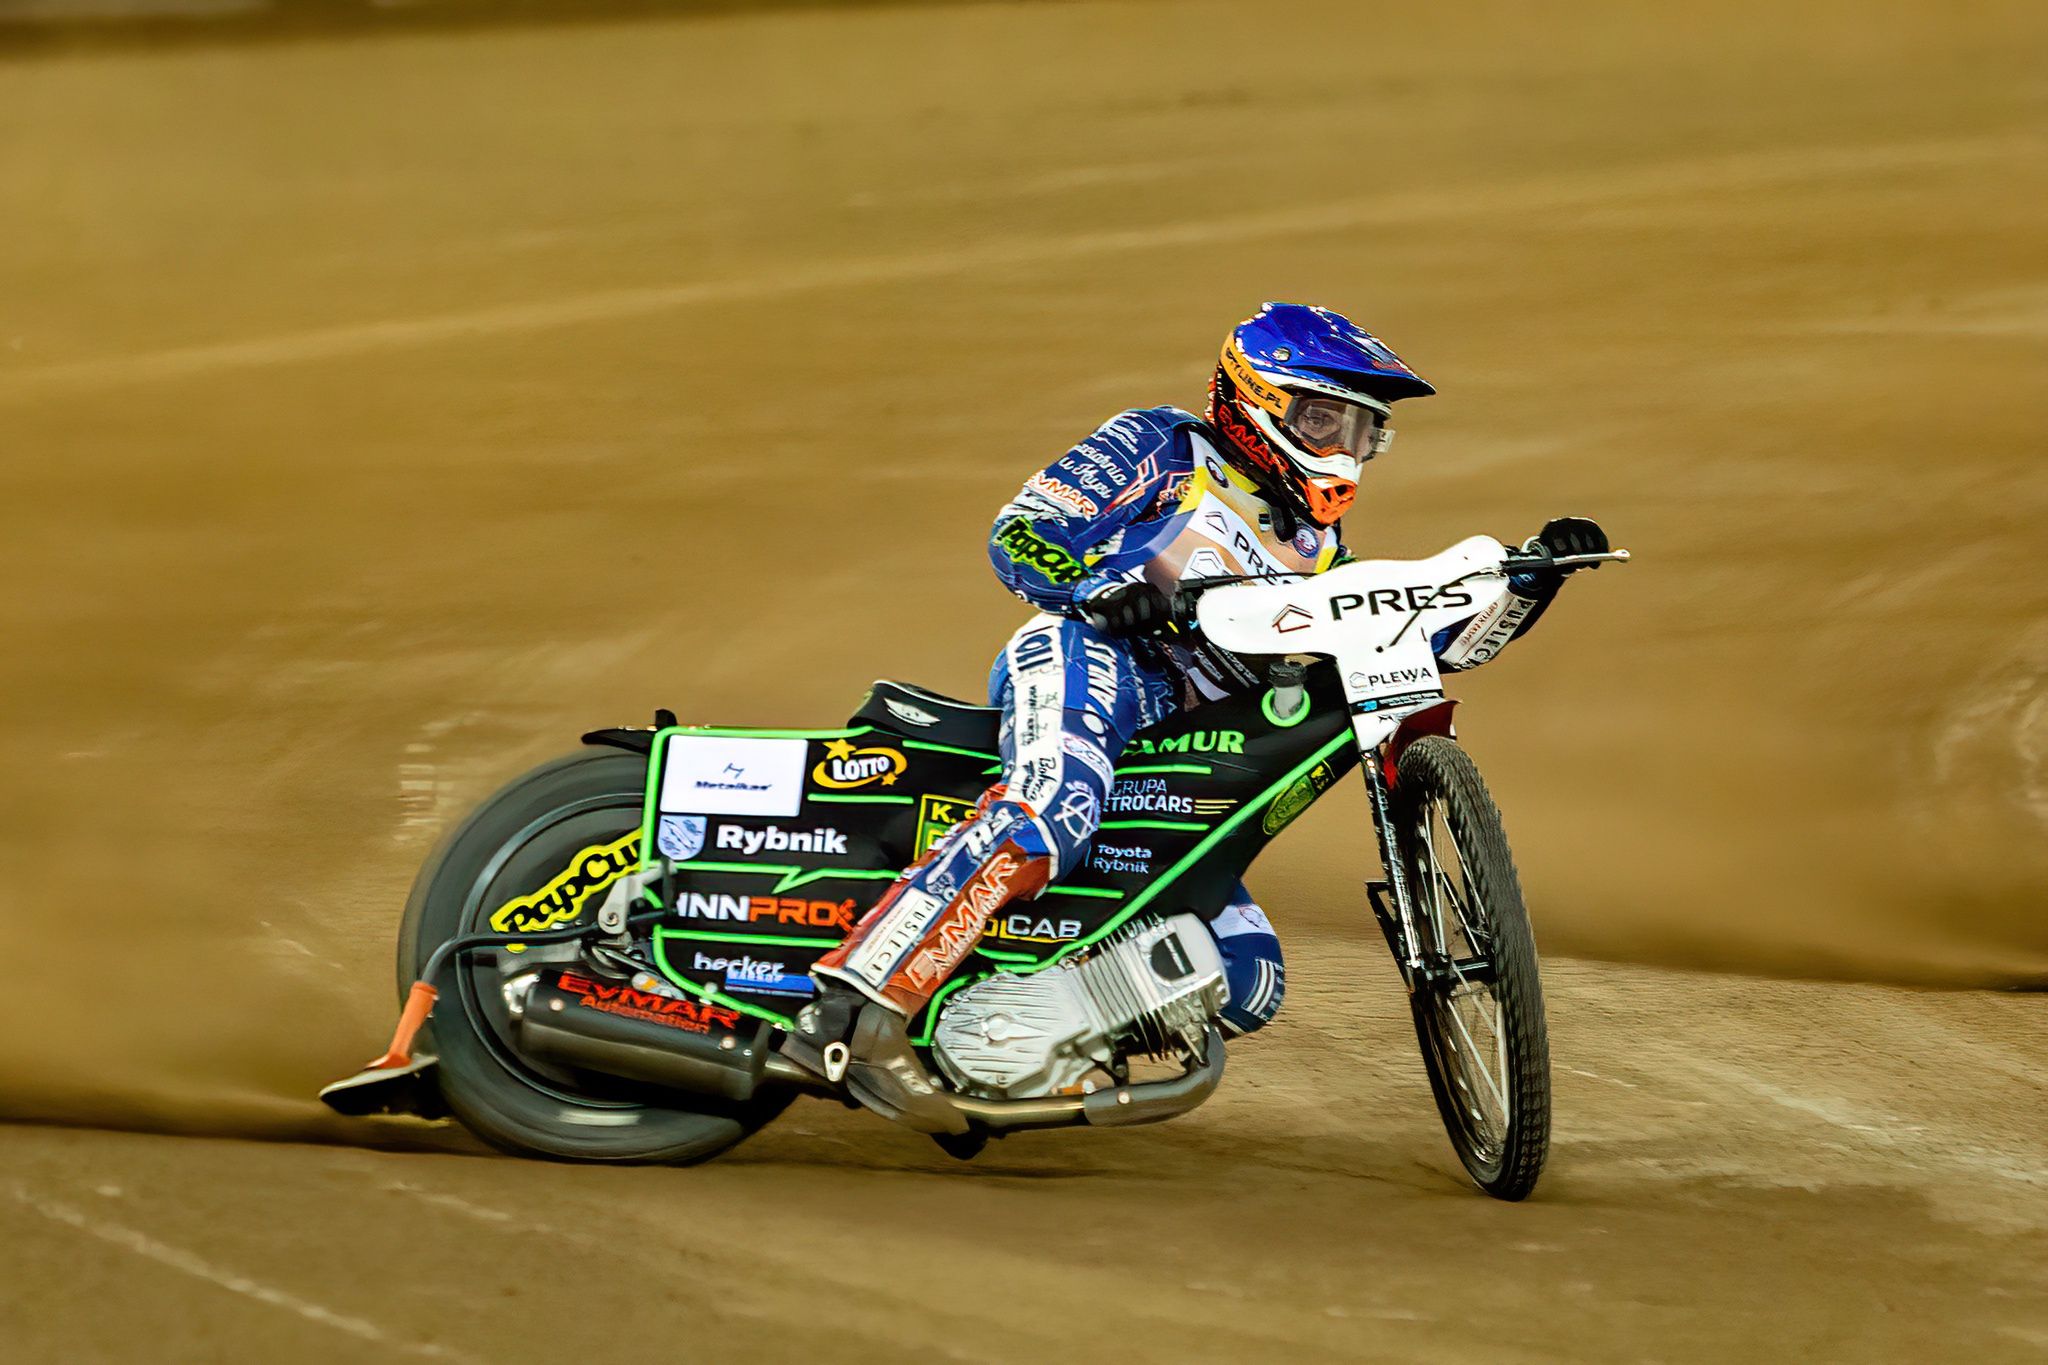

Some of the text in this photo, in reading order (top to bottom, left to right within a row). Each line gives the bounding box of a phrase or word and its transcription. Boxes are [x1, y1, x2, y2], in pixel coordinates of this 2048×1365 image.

[1328, 584, 1473, 621] PRES
[1368, 667, 1433, 687] PLEWA
[832, 756, 890, 781] LOTTO
[717, 825, 848, 854] Rybnik
[1098, 844, 1152, 860] Toyota
[1094, 857, 1149, 874] Rybnik
